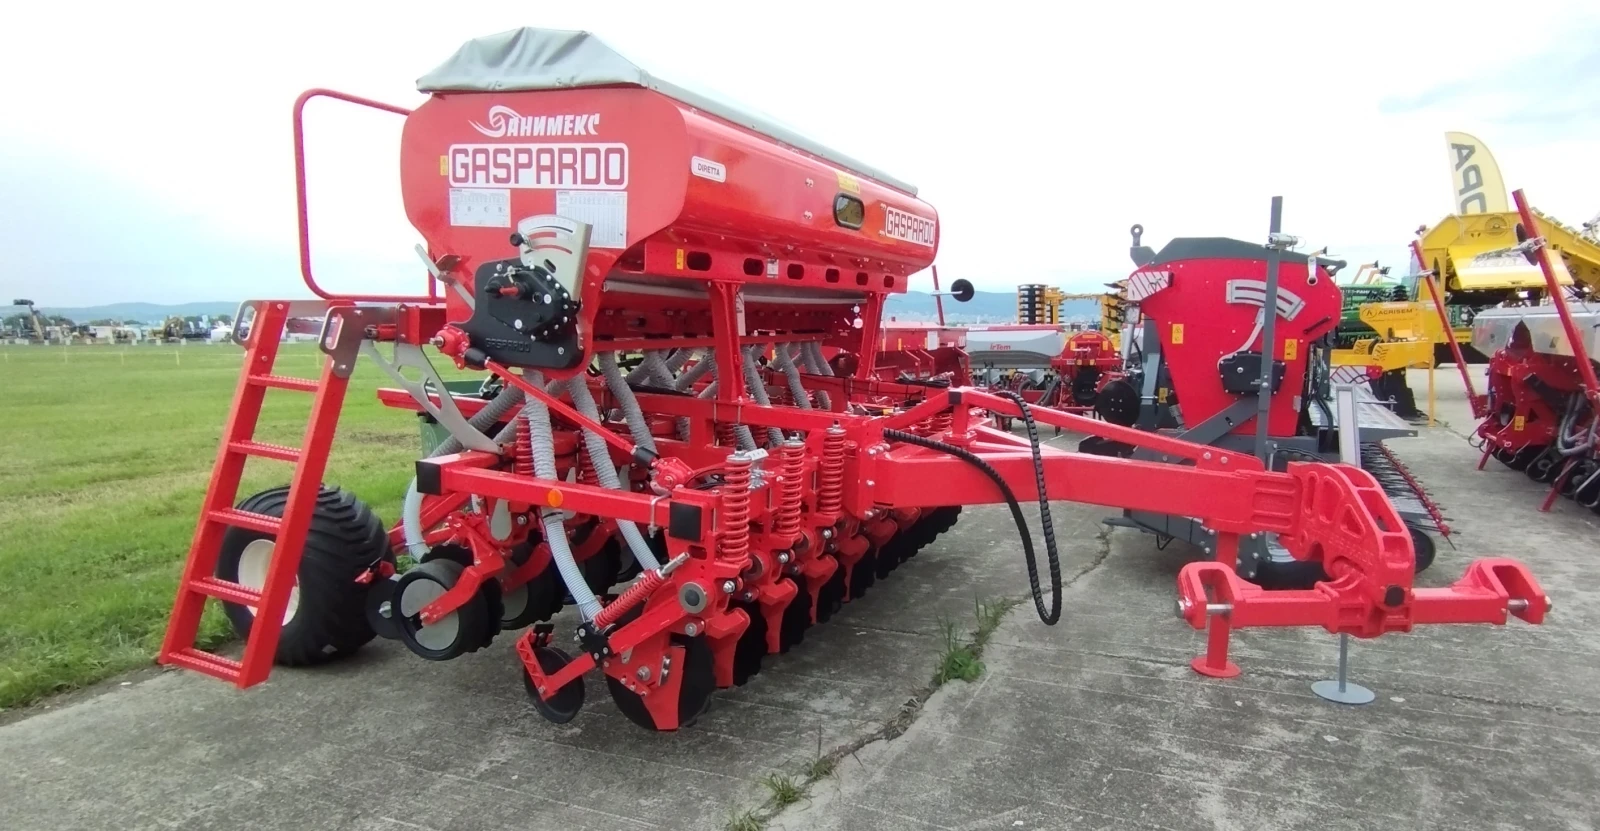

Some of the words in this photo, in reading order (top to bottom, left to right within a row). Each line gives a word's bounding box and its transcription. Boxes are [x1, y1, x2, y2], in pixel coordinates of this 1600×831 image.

[451, 147, 625, 185] GASPARDO
[697, 162, 721, 176] DIRETTA
[886, 209, 935, 245] GASPARDO
